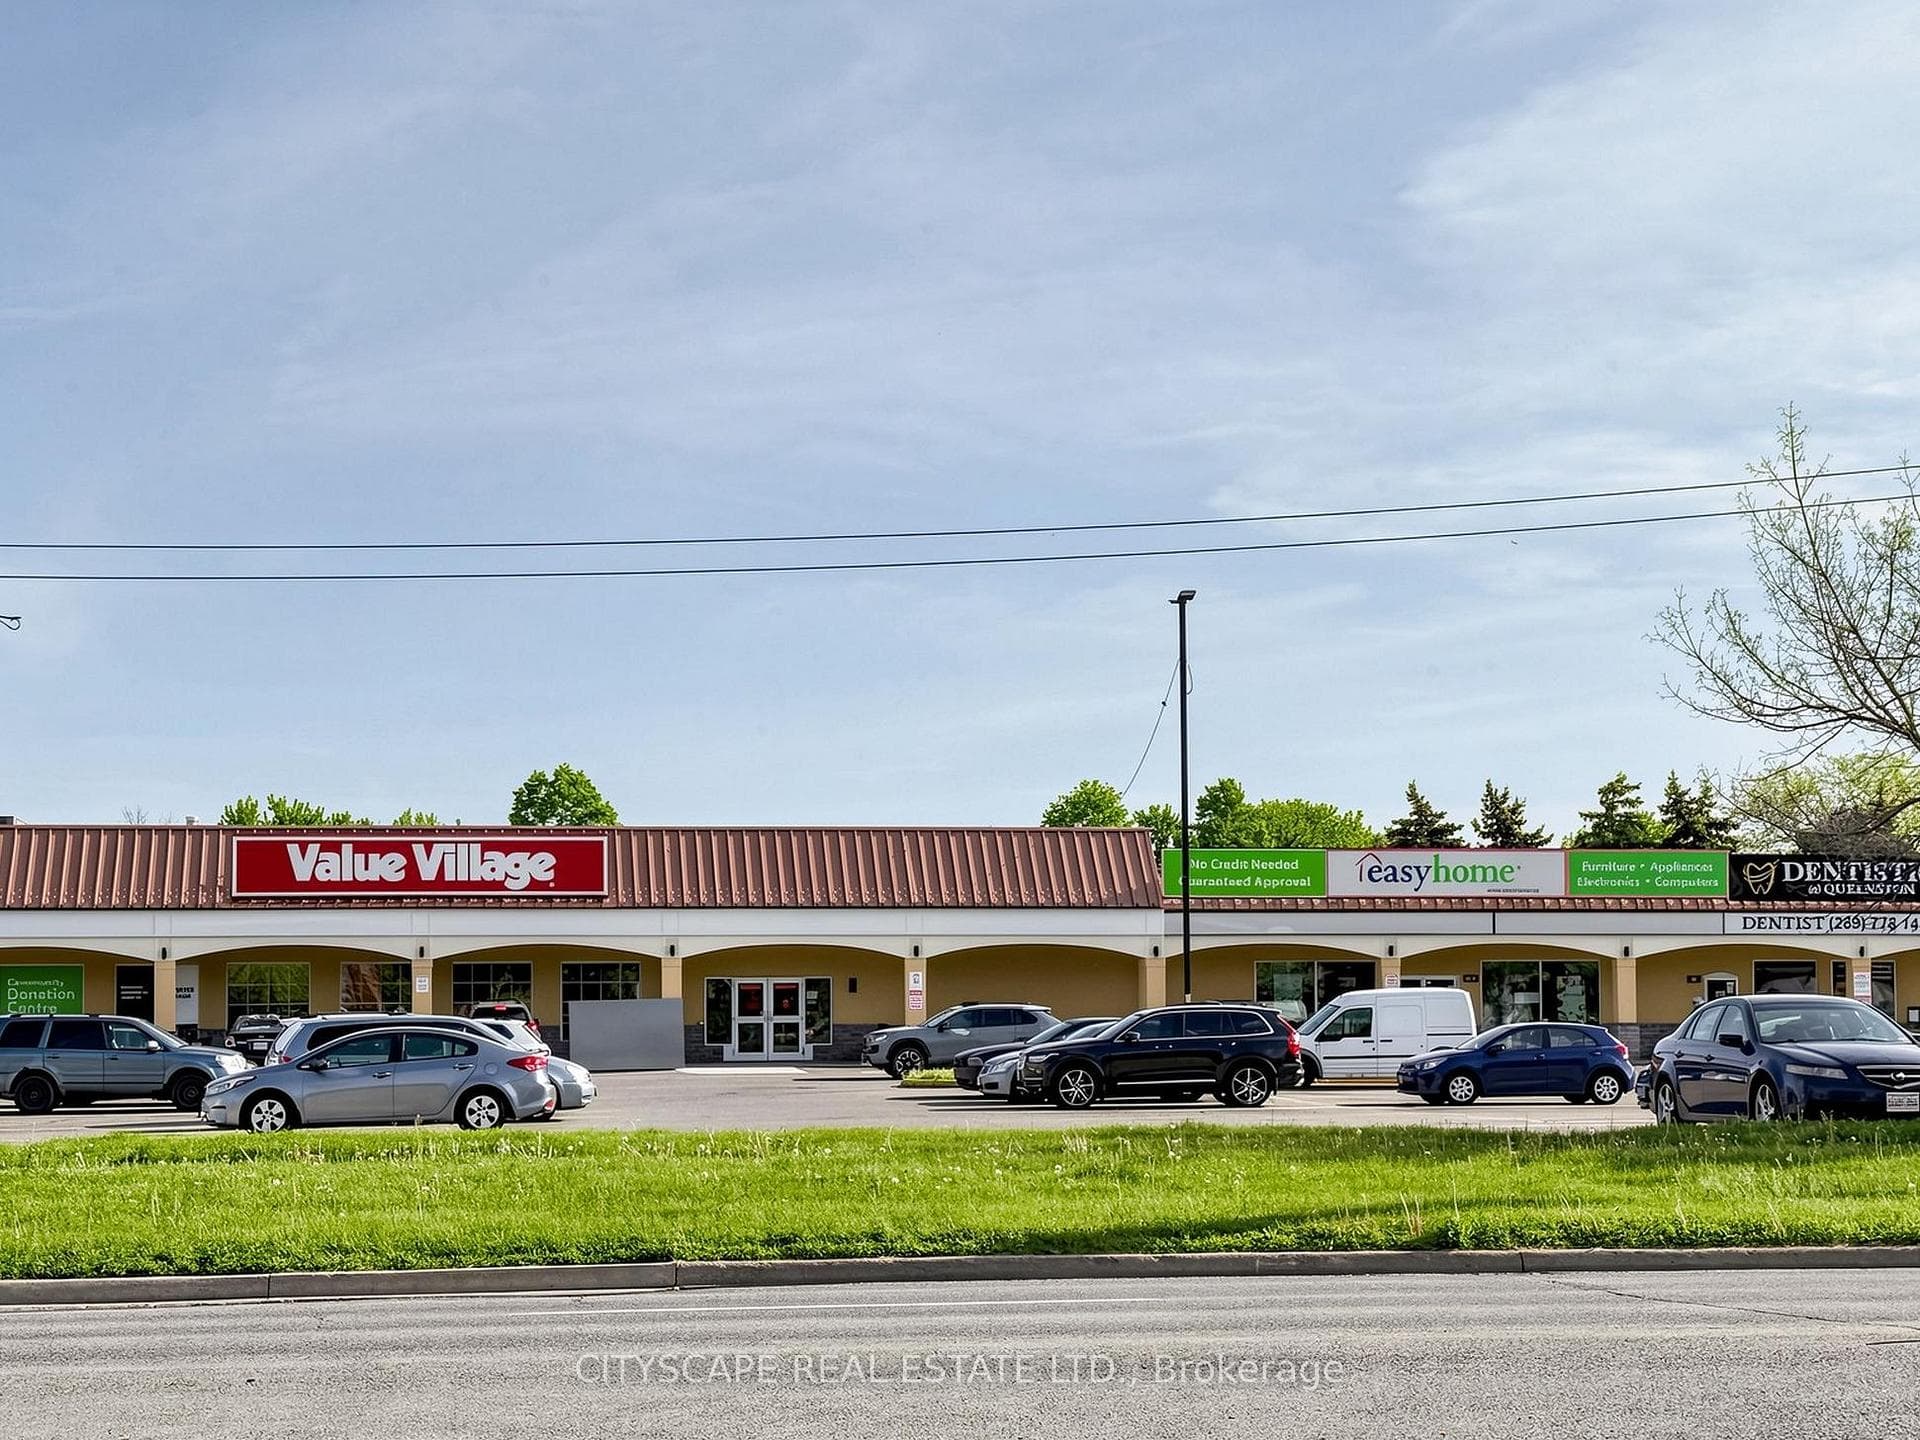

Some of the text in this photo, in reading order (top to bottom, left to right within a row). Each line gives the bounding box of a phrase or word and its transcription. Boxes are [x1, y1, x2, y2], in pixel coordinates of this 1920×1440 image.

[287, 843, 556, 890] Value Village
[1190, 859, 1299, 870] No Credit Needed
[1582, 861, 1713, 873] Furniture Appliances
[1367, 854, 1515, 892] easyhome
[1254, 876, 1311, 888] Approval
[1577, 876, 1719, 888] Electronics Computers
[1743, 916, 1825, 930] DENTIST
[8, 988, 75, 999] Donation
[8, 1001, 57, 1013] Centre
